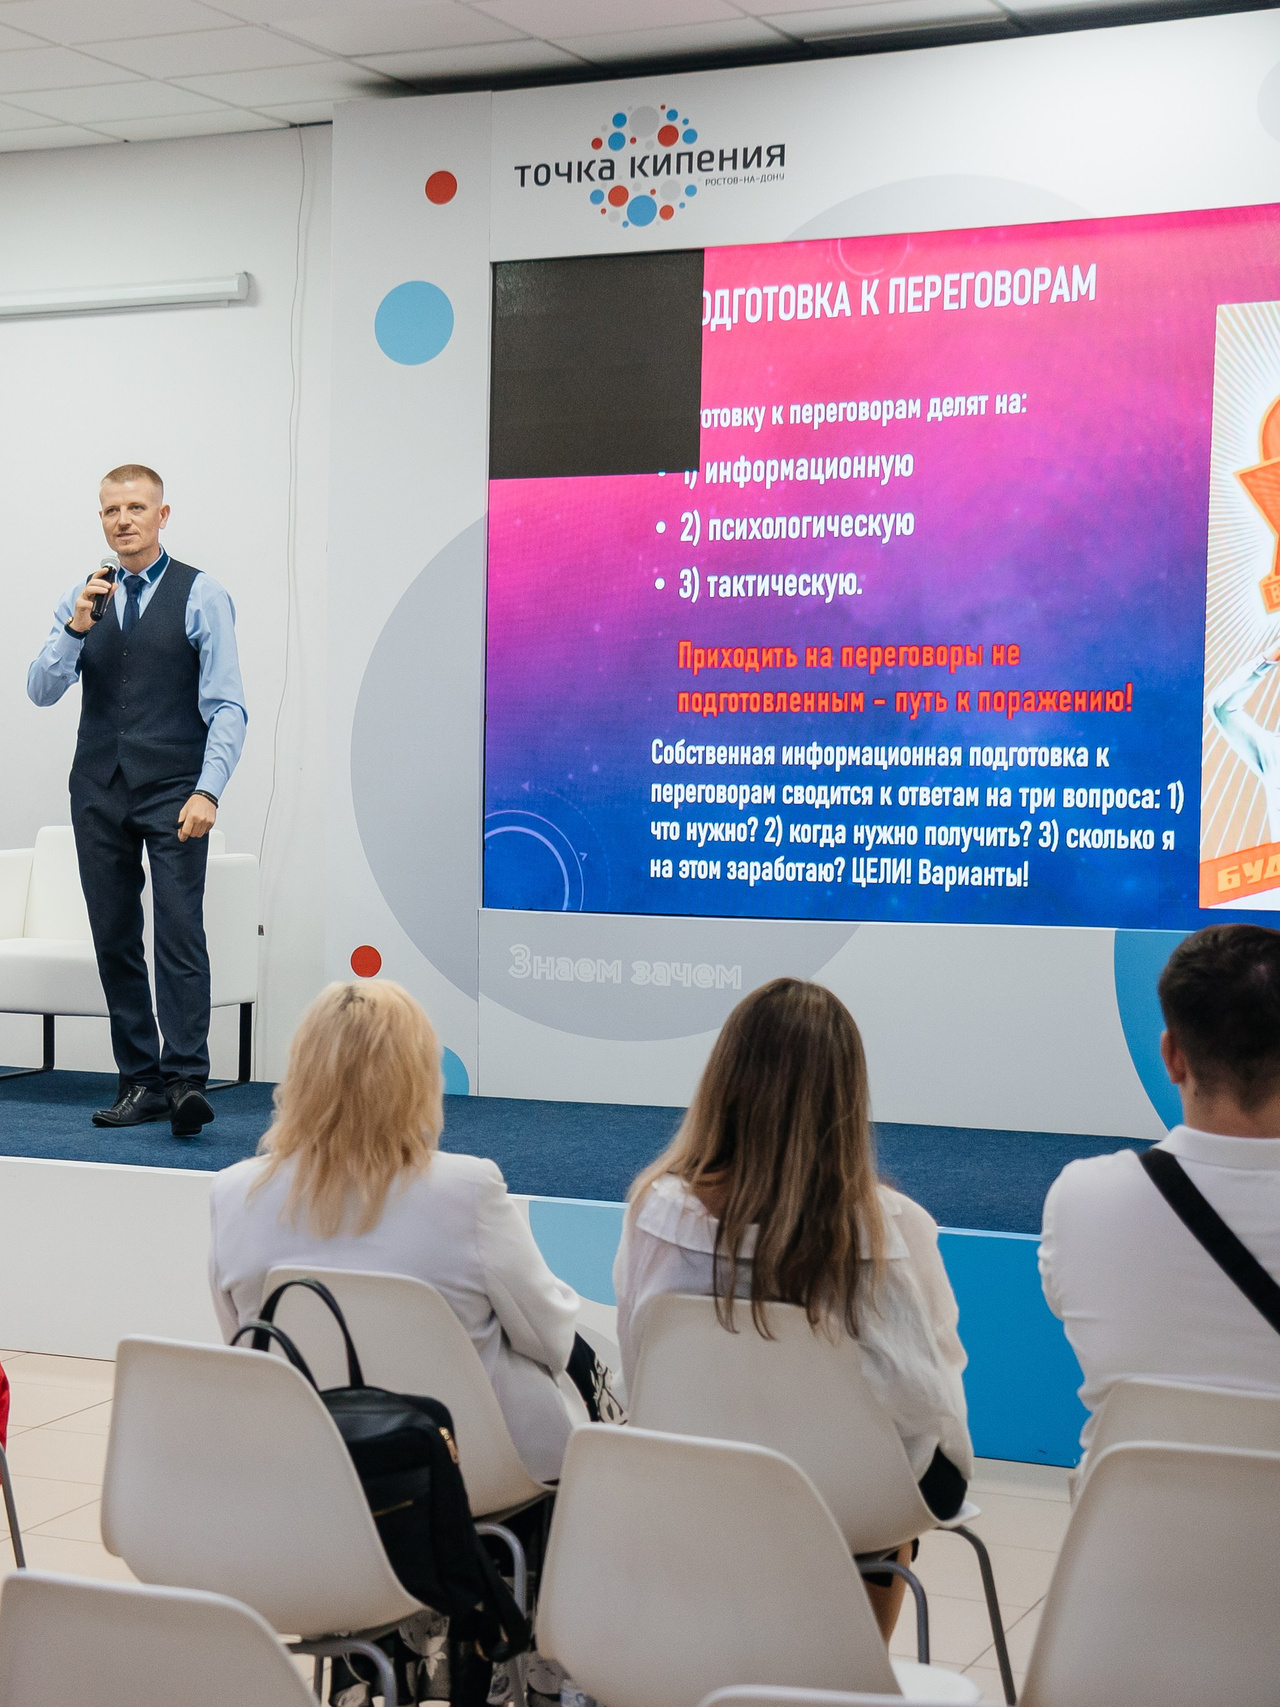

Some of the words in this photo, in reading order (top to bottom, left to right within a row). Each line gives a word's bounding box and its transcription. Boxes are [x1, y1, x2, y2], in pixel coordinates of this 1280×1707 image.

[705, 173, 785, 186] РОСТОВ-НА-ДОНУ
[860, 278, 880, 316] К
[888, 262, 1097, 314] ПЕРЕГОВОРАМ
[699, 406, 766, 433] отовку
[771, 404, 784, 426] к
[789, 398, 921, 430] переговорам
[926, 394, 989, 423] делят
[995, 392, 1028, 415] на:
[705, 453, 914, 490] информационную
[680, 509, 701, 547] 2)
[708, 511, 915, 544] психологическую
[679, 565, 700, 604] 3)
[707, 571, 863, 604] тактическую.
[678, 640, 798, 675] Приходить
[806, 647, 833, 669] на
[841, 643, 983, 675] переговоры
[992, 643, 1020, 666] не
[678, 690, 864, 717] подготовленным
[895, 690, 948, 720] путь
[957, 690, 970, 712] к
[978, 682, 1134, 719] поражению!
[651, 738, 775, 765] Собственная
[782, 741, 961, 772] информационная
[969, 746, 1088, 771] подготовка
[1096, 747, 1110, 768] к
[651, 783, 775, 810] переговорам
[782, 785, 873, 809] сводится
[880, 786, 893, 806] к
[898, 785, 979, 807] ответам
[986, 787, 1012, 807] на
[1019, 787, 1055, 814] три
[1062, 787, 1161, 815] вопроса:
[1167, 780, 1185, 815] 1)
[650, 820, 680, 841] что
[686, 816, 759, 848] нужно?
[764, 814, 783, 847] 2)
[789, 823, 847, 848] когда
[853, 823, 918, 851] нужно
[925, 820, 1032, 853] получить?
[1038, 818, 1059, 853] 3)
[1066, 827, 1155, 850] сколько
[1162, 830, 1175, 851] я
[650, 858, 673, 879] на
[678, 859, 721, 880] этом
[726, 855, 846, 887] заработаю?
[851, 856, 912, 888] ЦЕЛИ!
[918, 858, 1029, 892] Варианты!
[508, 943, 622, 984] Знаем
[630, 960, 742, 990] зачем
